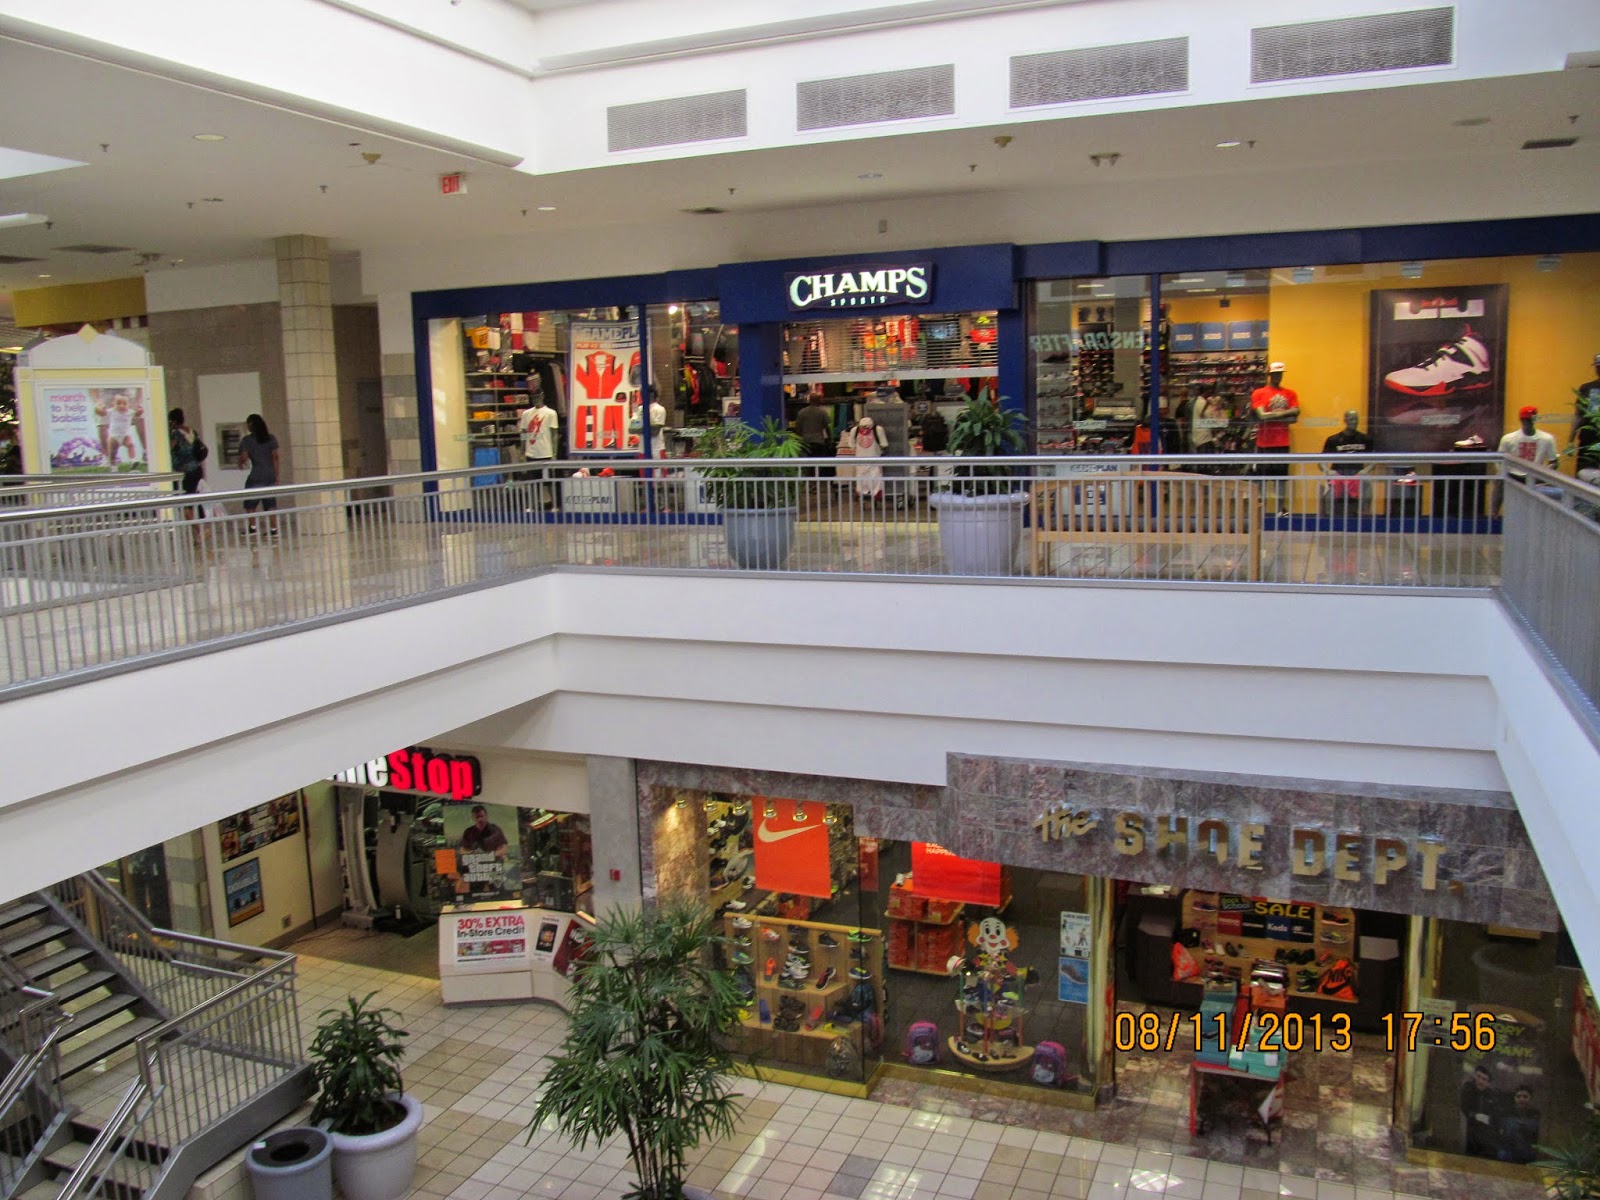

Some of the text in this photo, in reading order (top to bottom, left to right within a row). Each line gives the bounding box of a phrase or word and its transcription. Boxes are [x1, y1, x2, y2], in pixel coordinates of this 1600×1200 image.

[442, 176, 460, 193] EXIT
[789, 266, 928, 307] CHAMPS
[830, 295, 886, 307] SPORTS
[582, 326, 640, 341] GAMEPL
[51, 404, 87, 415] to help
[51, 413, 87, 422] babies
[325, 749, 474, 801] eStop
[1033, 806, 1098, 843] the
[1115, 811, 1265, 871] SHOE
[462, 849, 495, 866] grand
[468, 863, 502, 874] theft
[1254, 901, 1312, 919] SALE
[457, 916, 525, 929] 30% EXTRA
[457, 926, 525, 938] In-Store Credit
